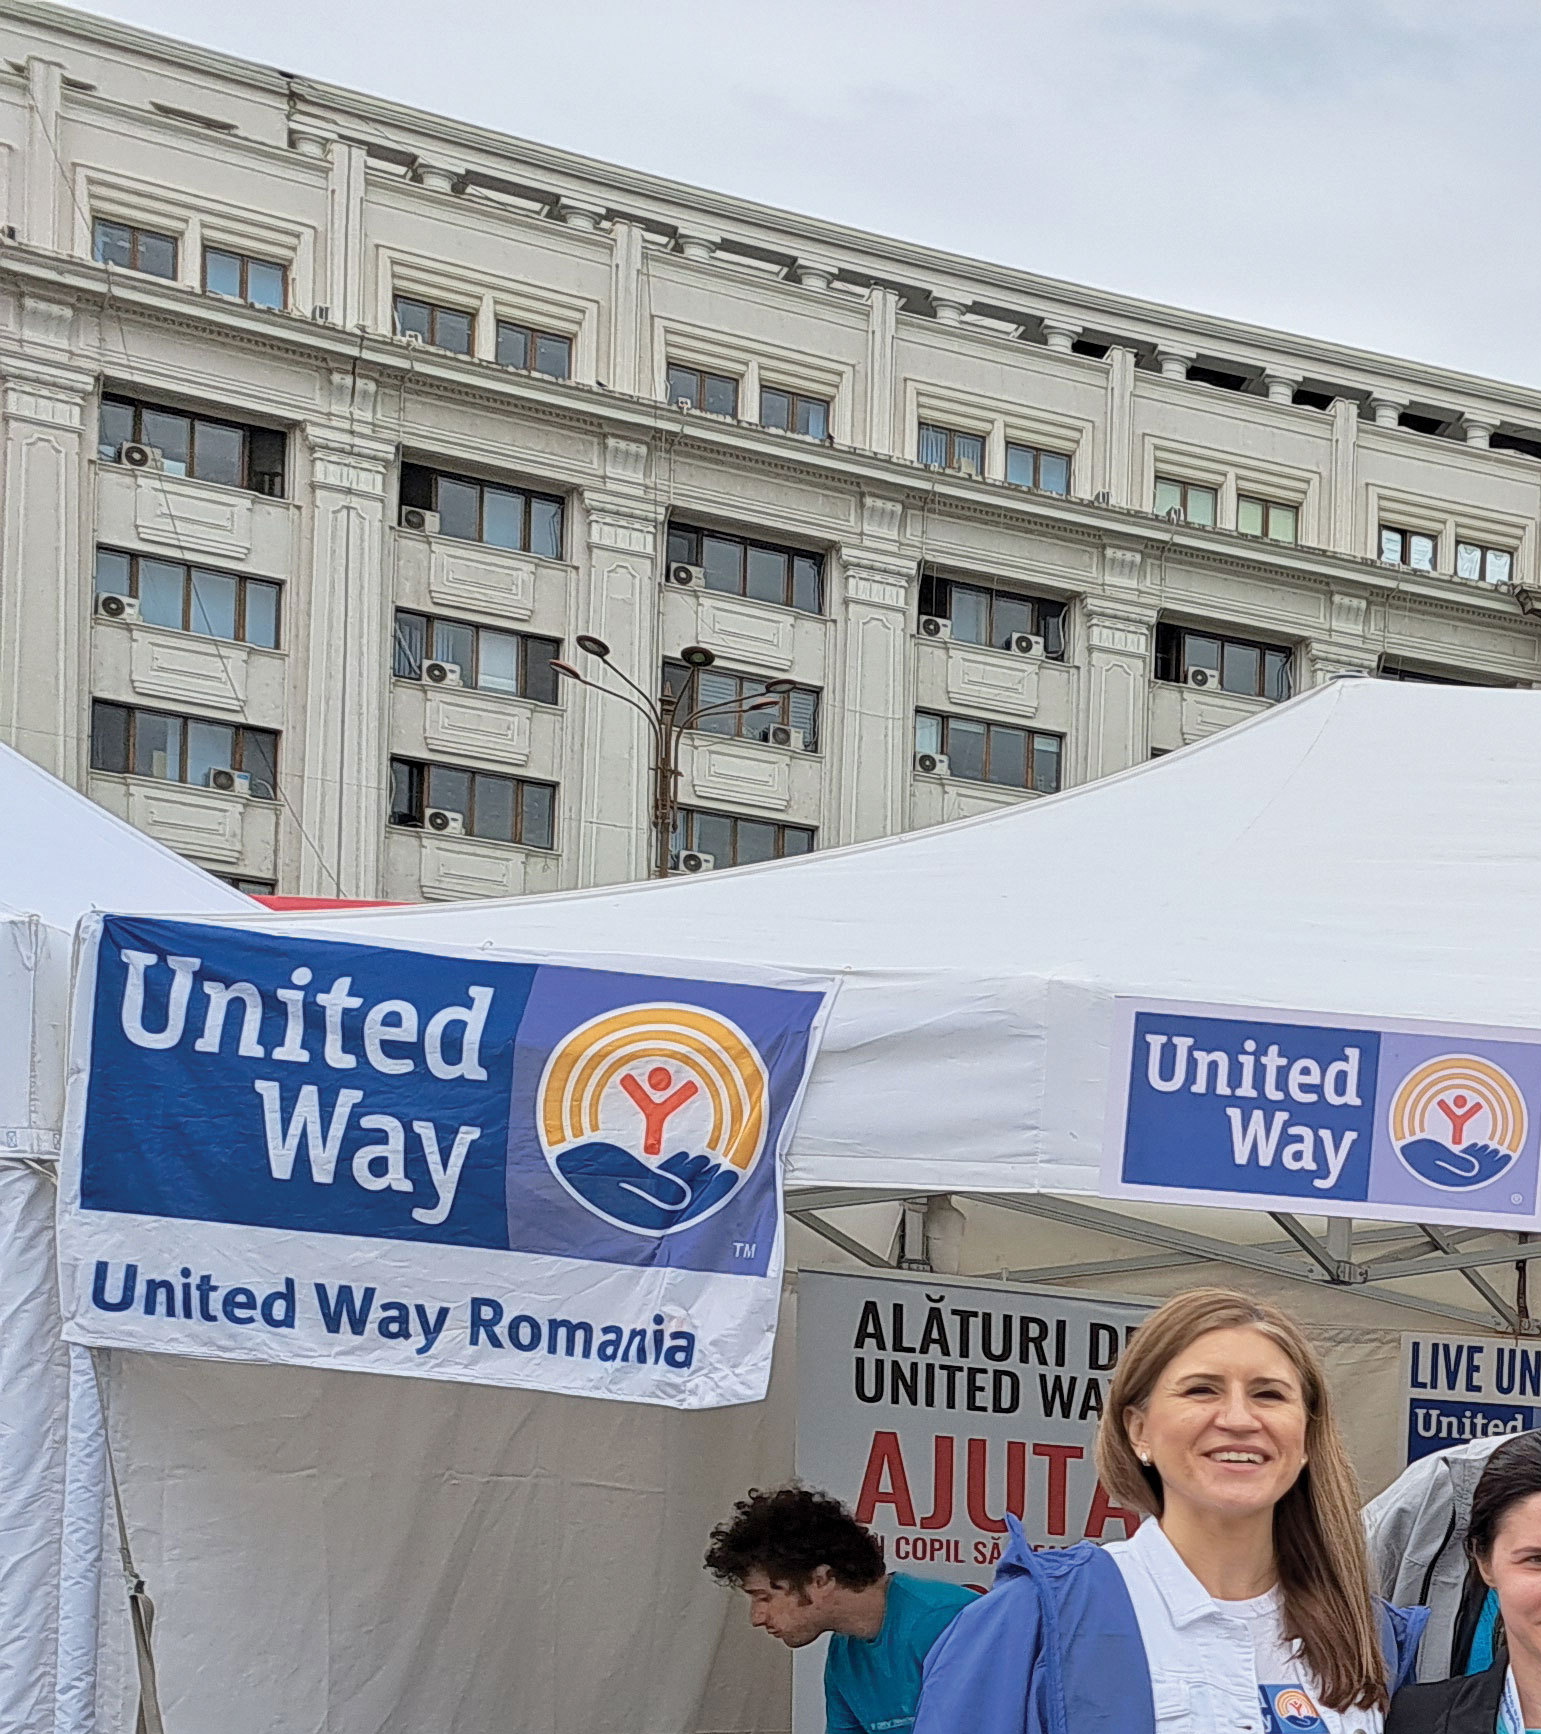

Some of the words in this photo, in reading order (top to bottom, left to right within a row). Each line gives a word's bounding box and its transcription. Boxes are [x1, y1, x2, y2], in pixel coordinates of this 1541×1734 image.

[119, 948, 489, 1081] United
[1144, 1033, 1362, 1107] United
[254, 1078, 482, 1225] Way
[1226, 1106, 1358, 1190] Way
[92, 1260, 296, 1329] United
[313, 1281, 451, 1355] Way
[469, 1297, 695, 1369] Romania
[854, 1293, 1066, 1367] ALĂTURI
[855, 1357, 1020, 1414] UNITED
[1039, 1373, 1112, 1421] WA
[1410, 1341, 1484, 1393] LIVE
[1414, 1408, 1524, 1439] United
[895, 1536, 965, 1564] COPIL
